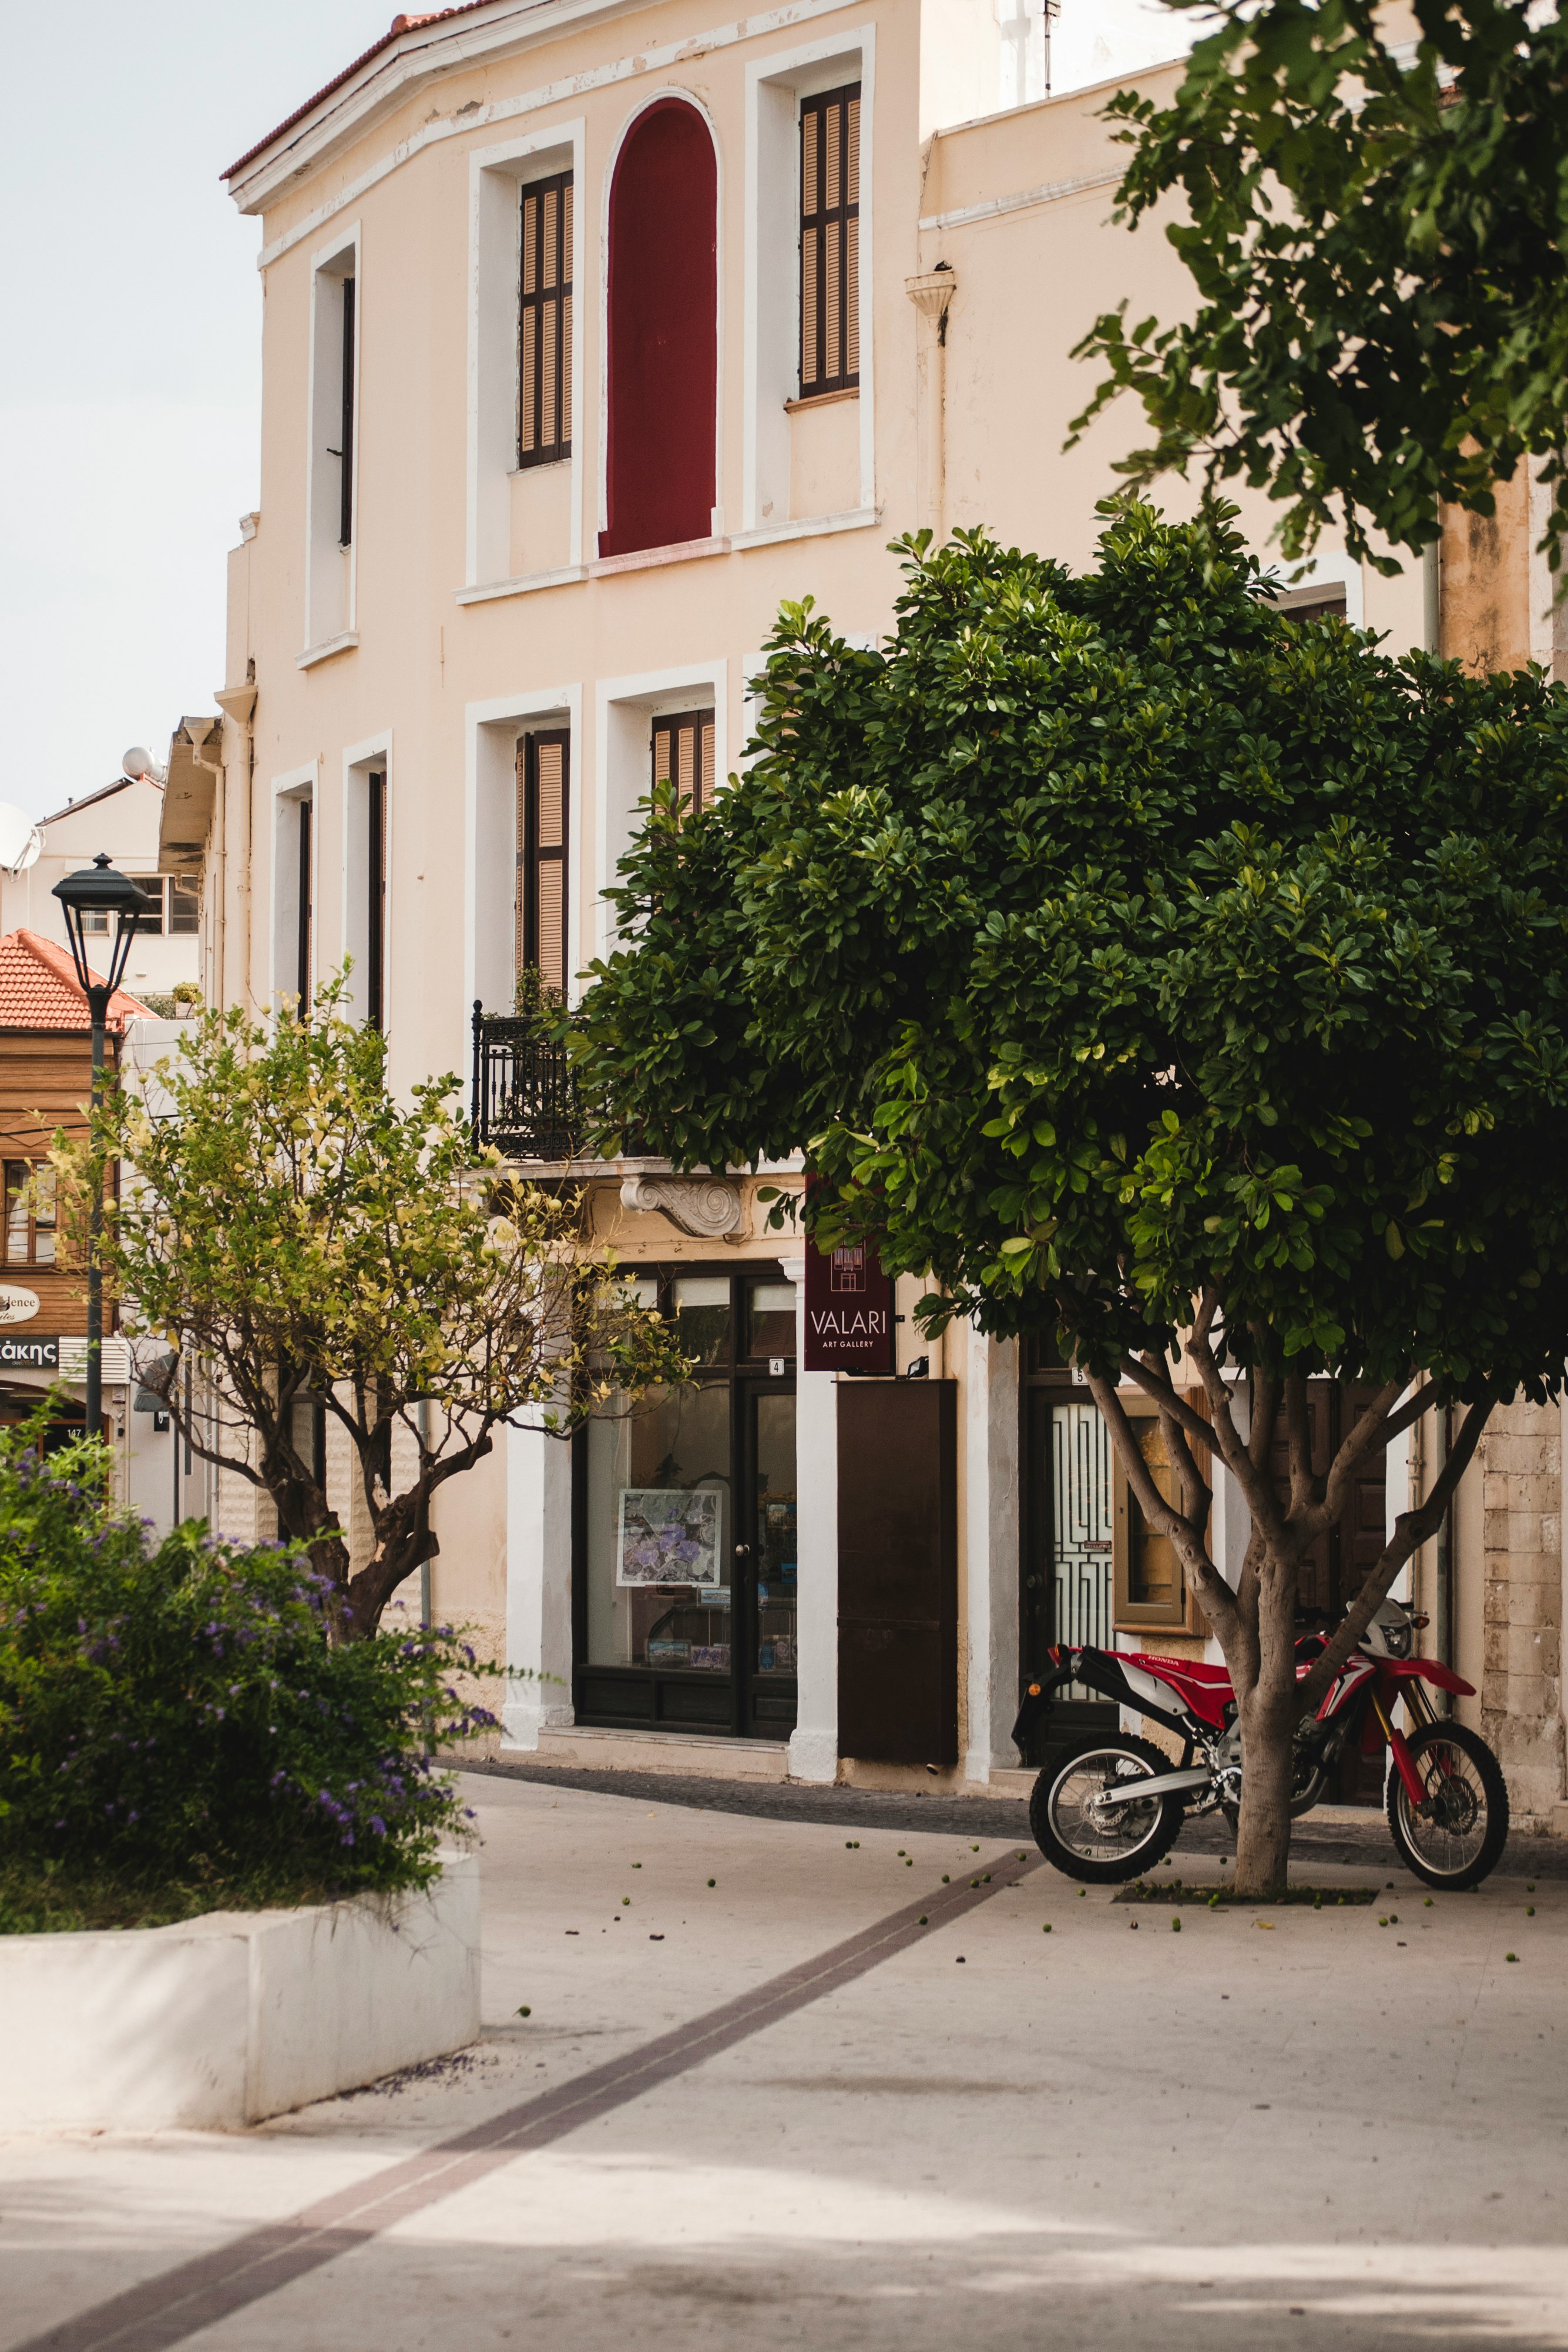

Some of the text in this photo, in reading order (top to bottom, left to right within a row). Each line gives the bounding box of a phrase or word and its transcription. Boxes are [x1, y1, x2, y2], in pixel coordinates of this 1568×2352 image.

[811, 1310, 886, 1335] VALARI
[0, 1340, 56, 1365] άκης
[774, 1362, 779, 1373] 4
[1077, 1370, 1083, 1382] 5
[67, 1429, 82, 1437] 147
[1148, 1655, 1179, 1666] HONDA
